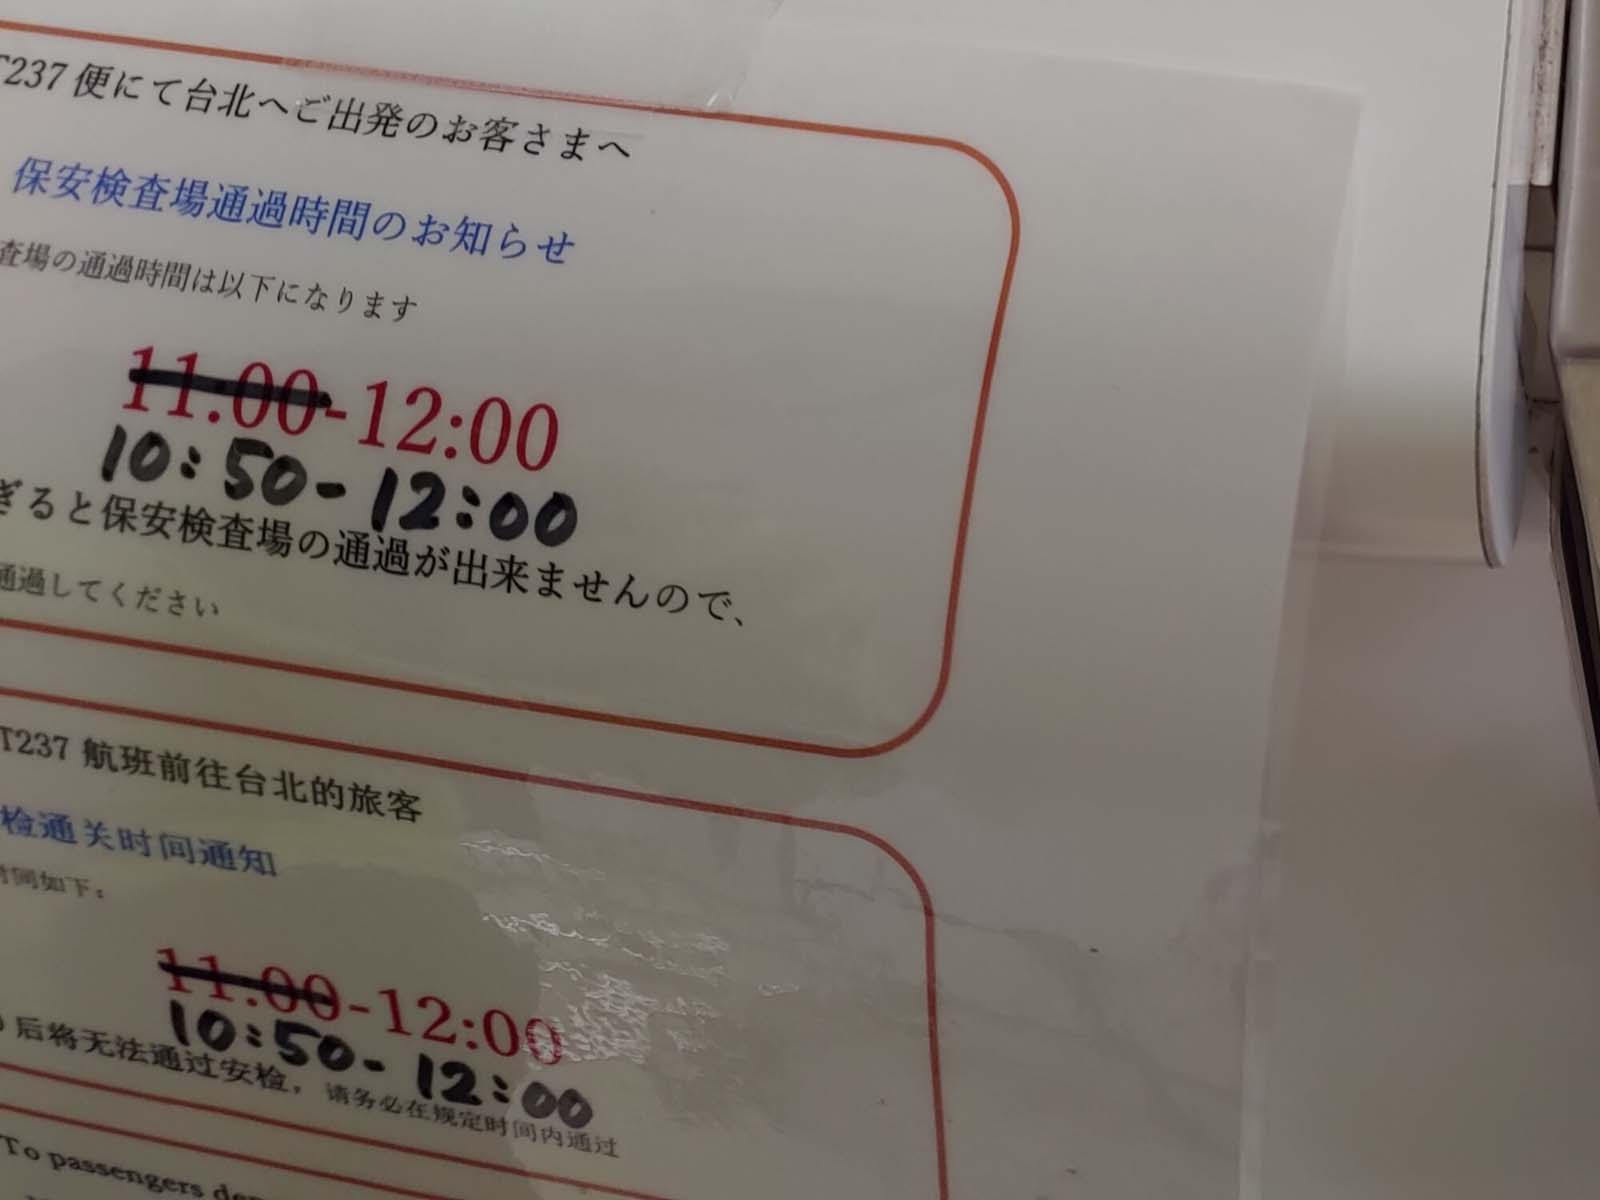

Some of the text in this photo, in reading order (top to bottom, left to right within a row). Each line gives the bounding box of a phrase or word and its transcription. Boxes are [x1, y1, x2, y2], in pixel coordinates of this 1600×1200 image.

[73, 62, 632, 163] 便にて台北へご出発のお客さまへ
[12, 155, 576, 266] 保安検査場通過時間のお知らせ
[0, 238, 418, 323] 査場の通過時間は以下になります
[83, 737, 424, 824] 航班前往台北的旅客
[0, 806, 278, 877] 检通关时间通知
[0, 1134, 40, 1161] To
[48, 1151, 204, 1199] passengers
